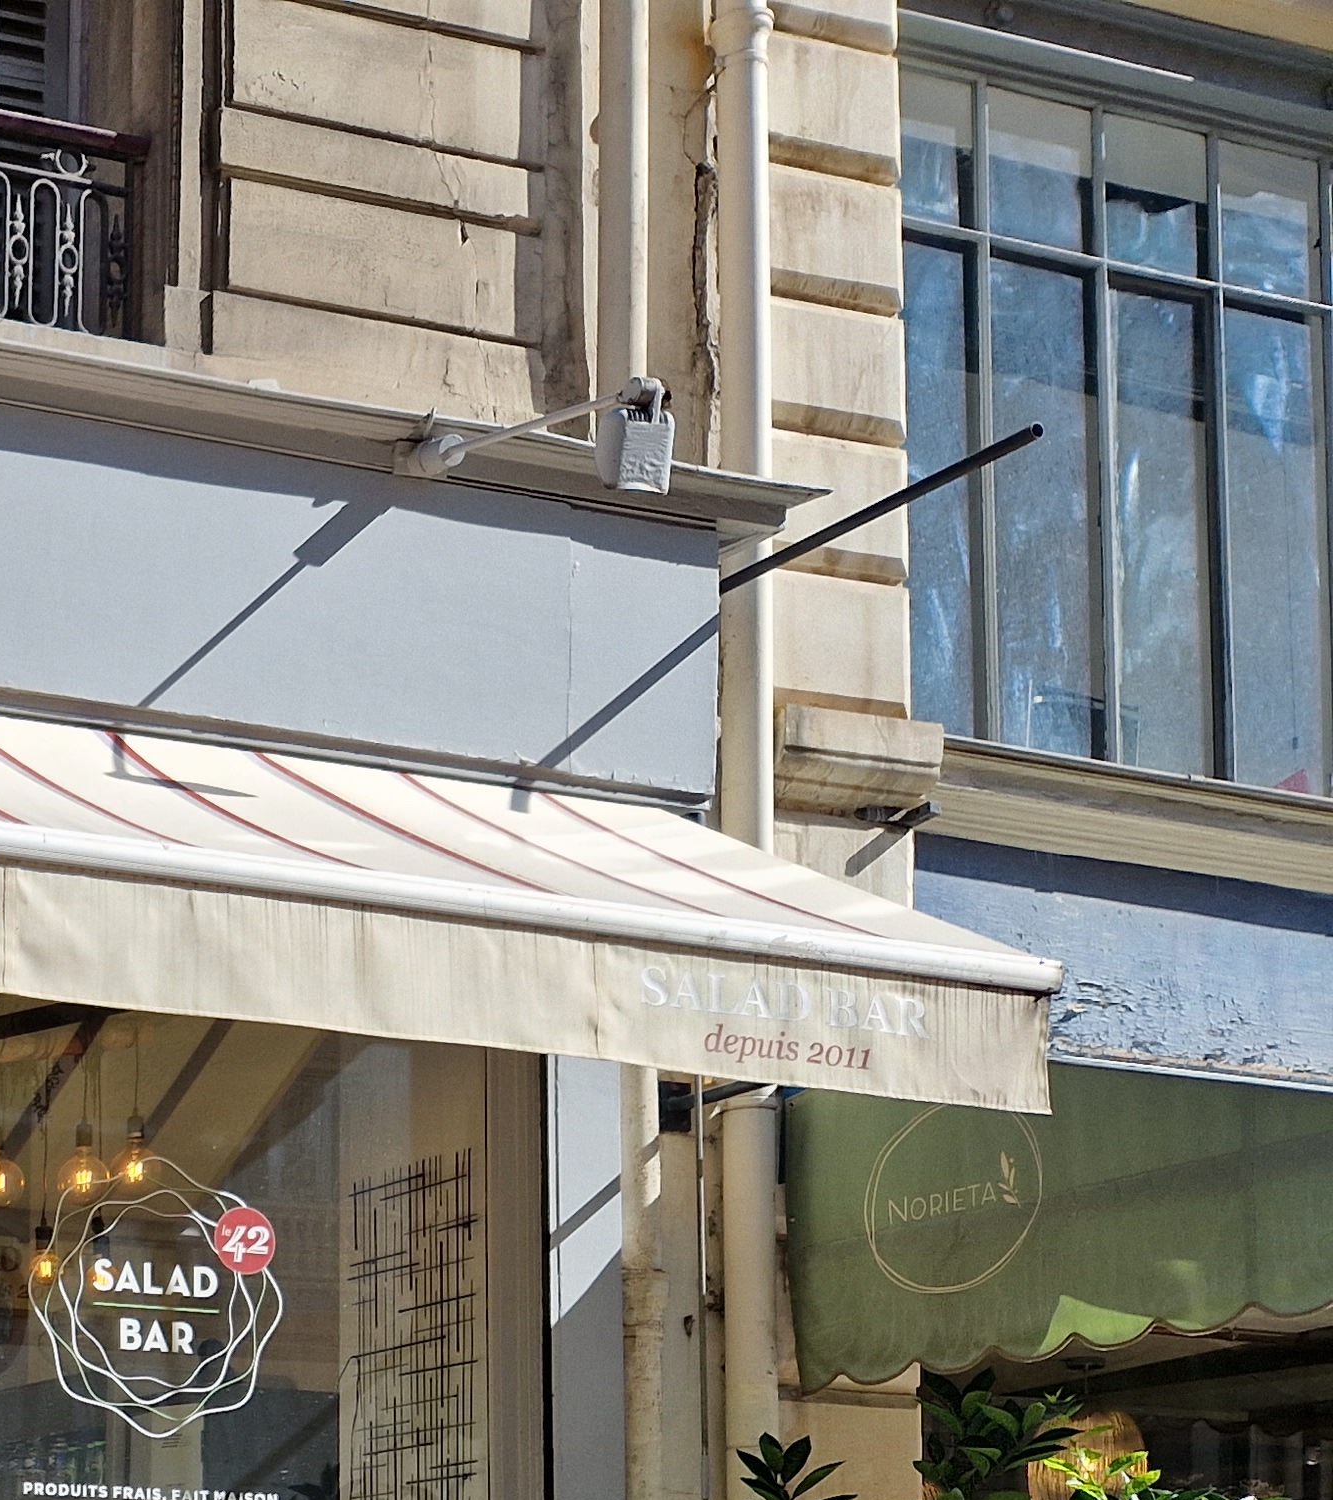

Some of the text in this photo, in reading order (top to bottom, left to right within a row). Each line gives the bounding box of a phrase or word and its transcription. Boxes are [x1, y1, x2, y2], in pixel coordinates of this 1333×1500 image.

[640, 966, 930, 1040] SALAD BAR
[703, 1023, 873, 1071] depuis 2011
[887, 1180, 996, 1225] NORIETA
[221, 1224, 271, 1264] le 42
[93, 1258, 220, 1299] SALAD
[118, 1317, 195, 1355] BAR
[22, 1481, 108, 1499] PRODUITS
